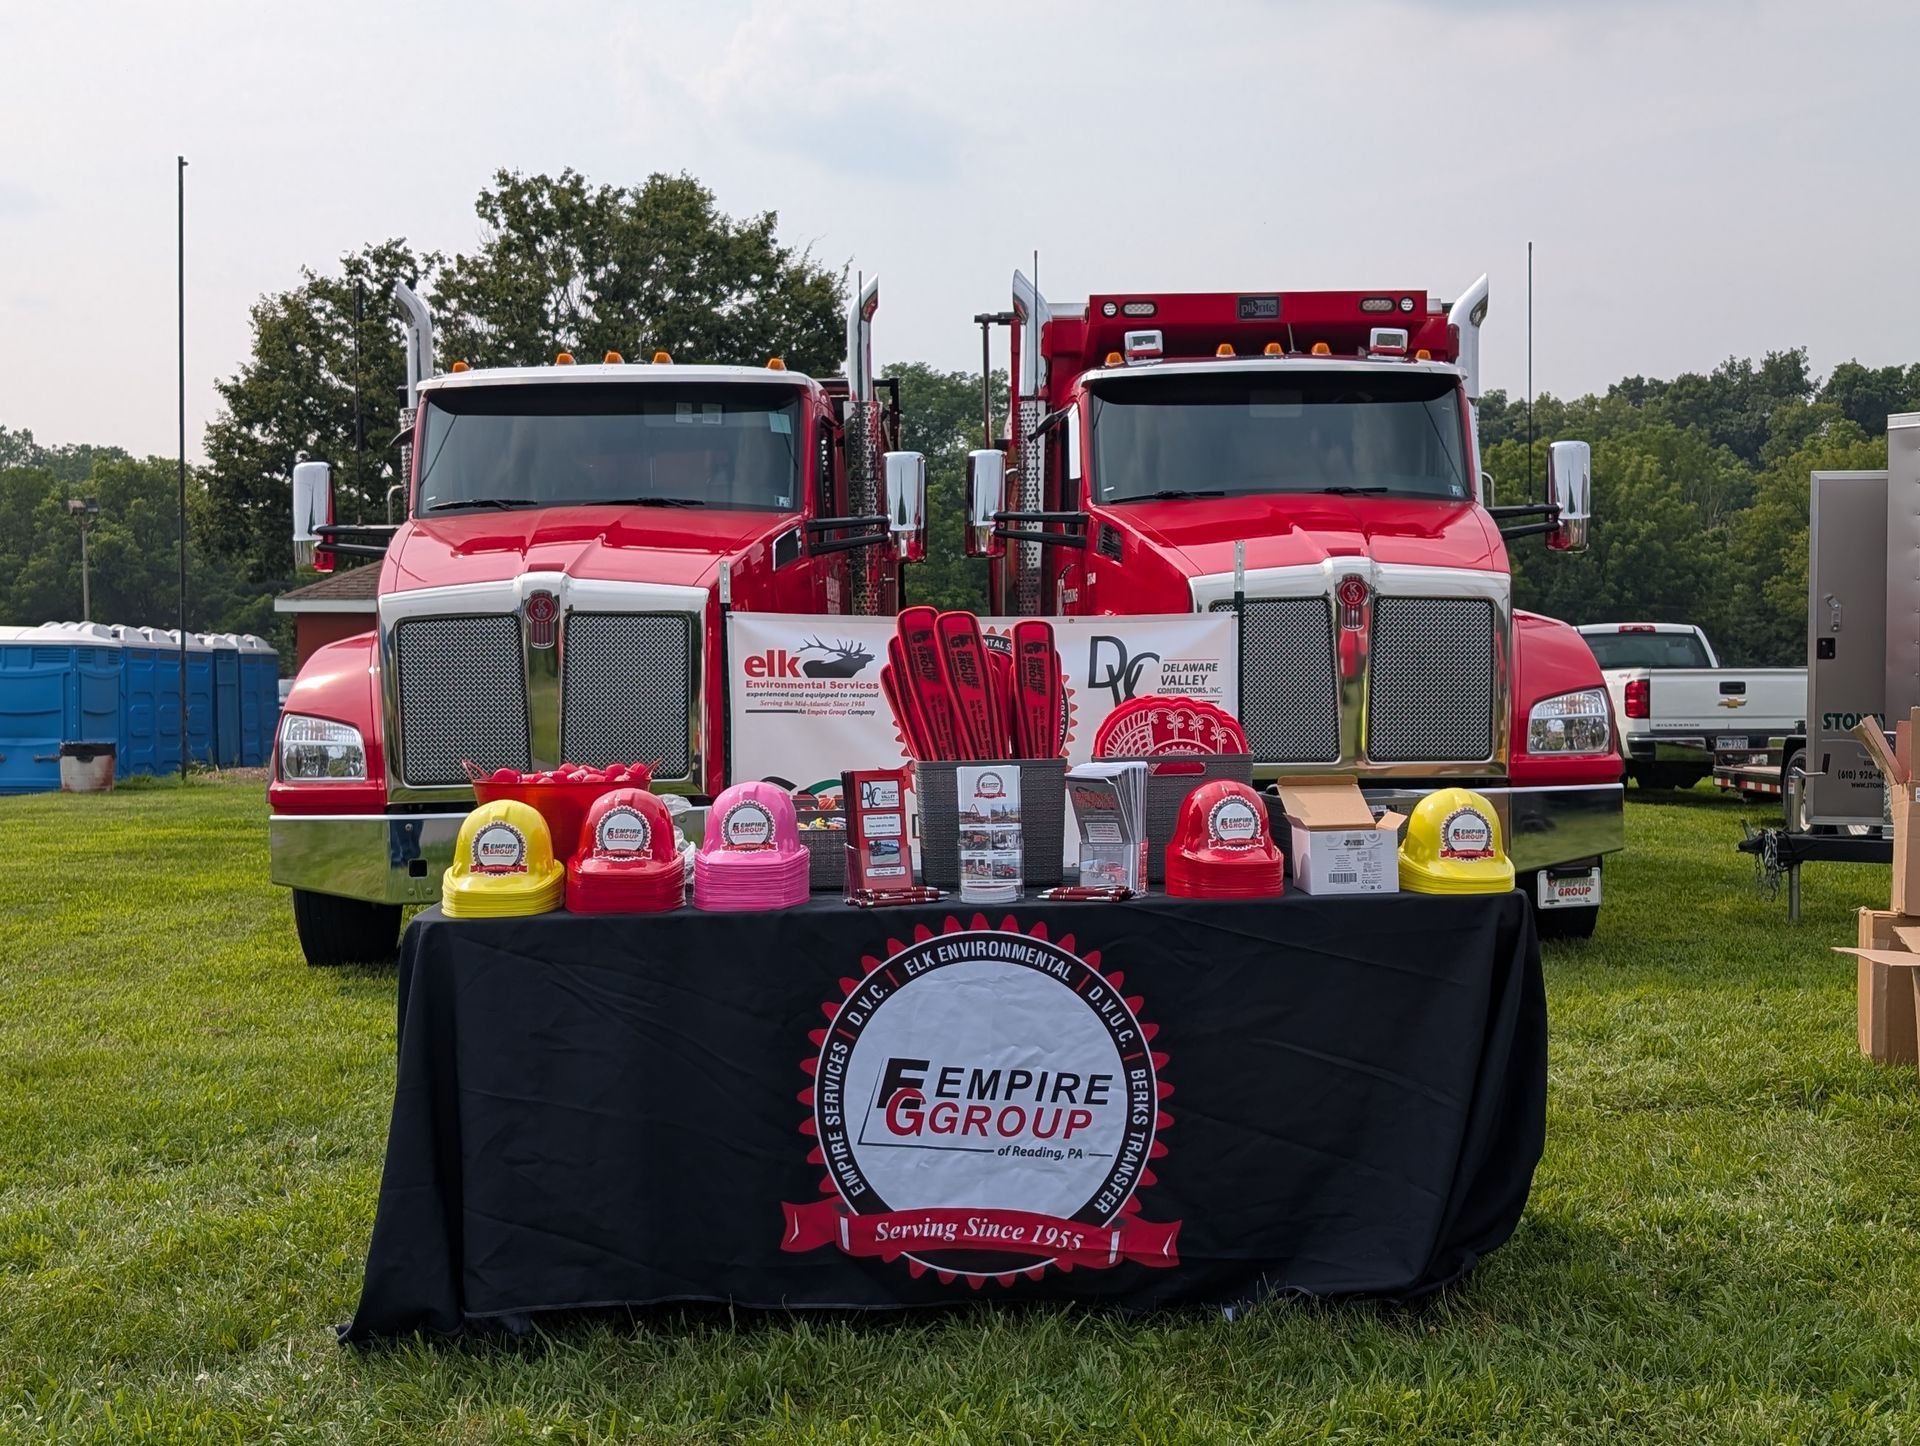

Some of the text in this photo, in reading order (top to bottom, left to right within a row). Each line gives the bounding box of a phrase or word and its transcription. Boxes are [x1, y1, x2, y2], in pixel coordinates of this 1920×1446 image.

[744, 650, 801, 678] elk
[1163, 663, 1218, 672] DELAWARE
[746, 680, 879, 690] Environmental Services
[1161, 675, 1208, 686] VALLEY
[760, 700, 782, 708] Serving
[1838, 770, 1856, 780] (610)
[1558, 887, 1592, 896] GROUP
[1559, 878, 1595, 887] EMPIRE
[904, 941, 1072, 981] ELK ENVIRONMENTAL
[848, 984, 889, 1026] D.V.C.
[1088, 986, 1134, 1048] D.V.U.C.
[935, 1066, 1113, 1105] EMPIRE
[824, 1042, 866, 1197] EMPIRE SERVICES
[929, 1102, 1092, 1139] GROUP
[998, 1146, 1083, 1160] of Reading, PA
[1094, 1068, 1149, 1214] BERKS TRANSFER
[875, 1217, 1084, 1250] Serving Since 1955
